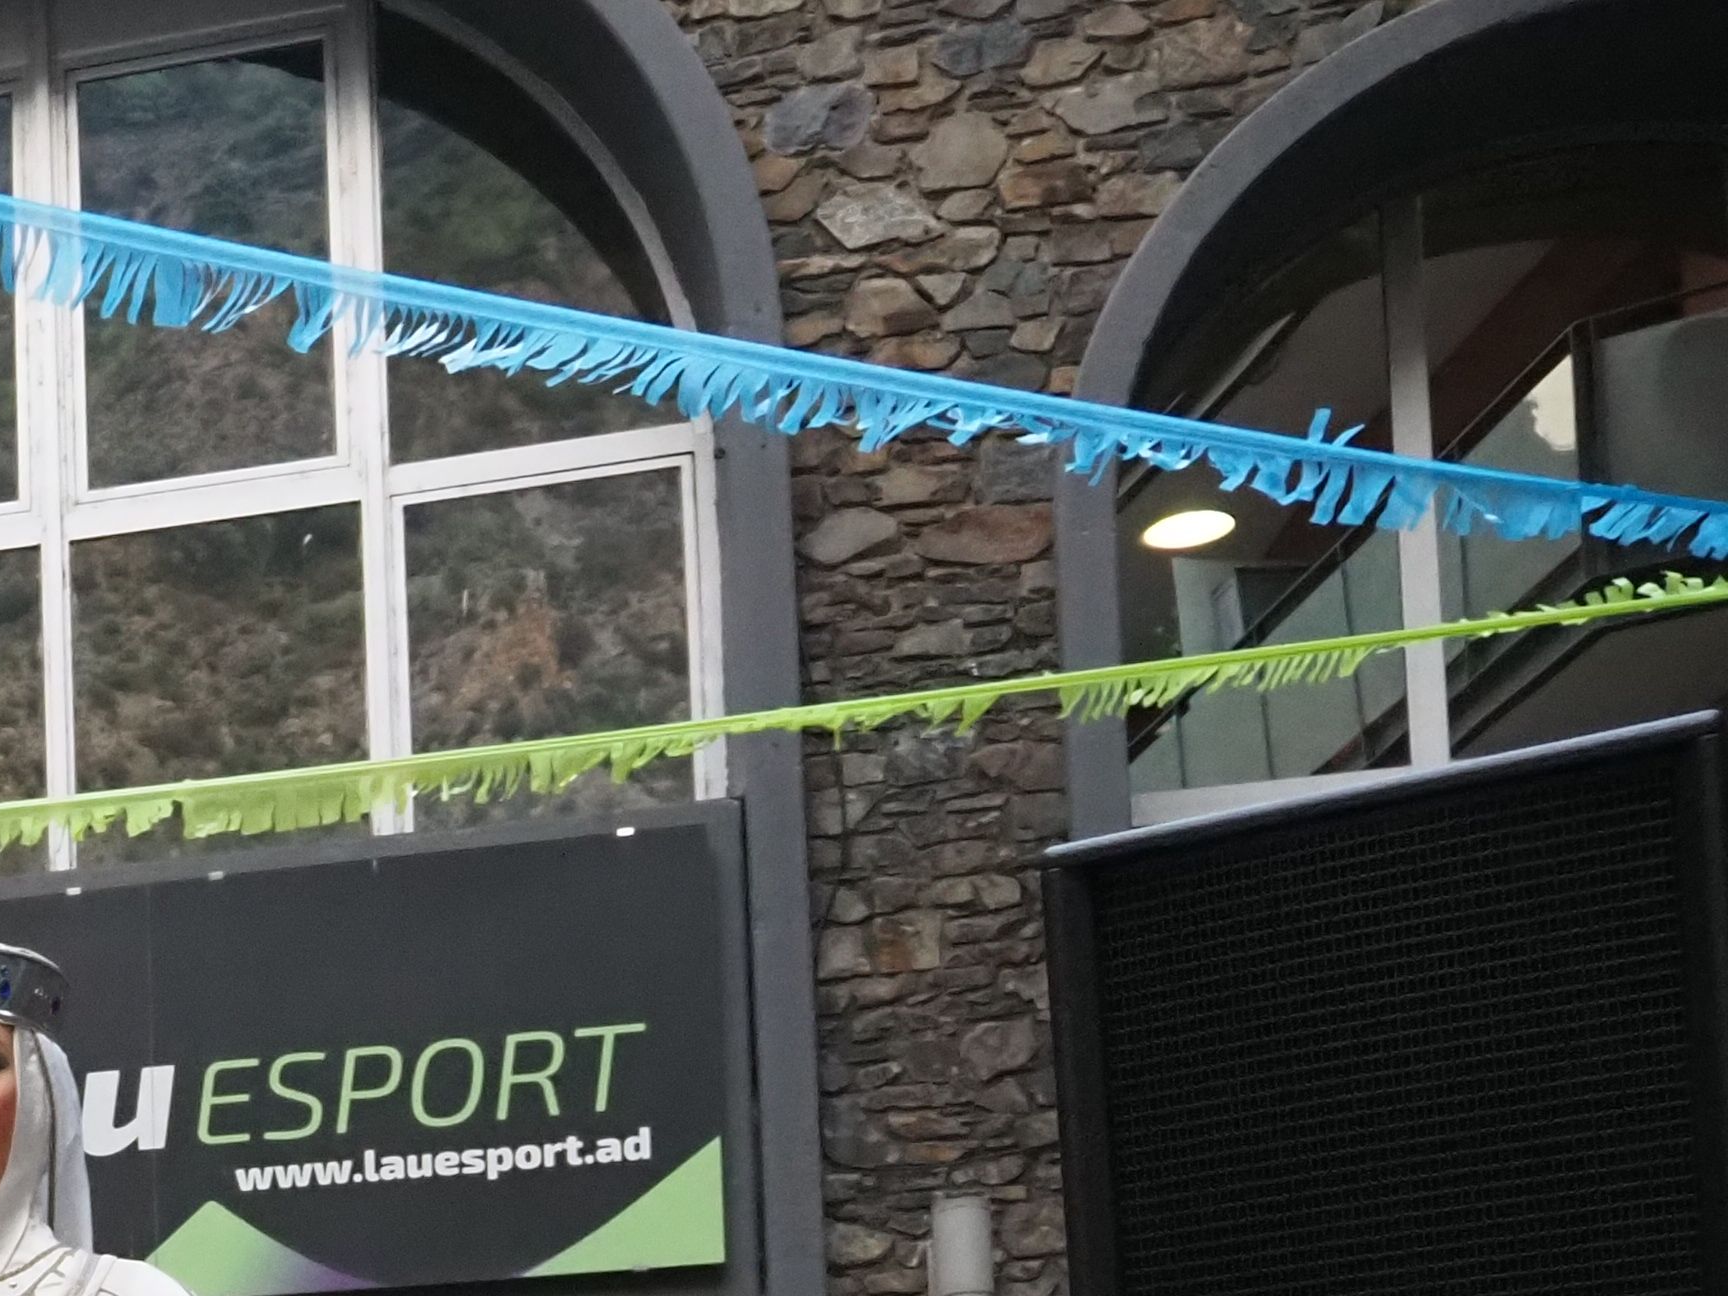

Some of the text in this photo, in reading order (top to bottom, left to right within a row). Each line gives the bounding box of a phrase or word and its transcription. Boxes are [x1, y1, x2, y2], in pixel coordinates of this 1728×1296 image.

[81, 1023, 647, 1157] u ESPORT
[234, 1126, 653, 1192] www.lauesport.ad
